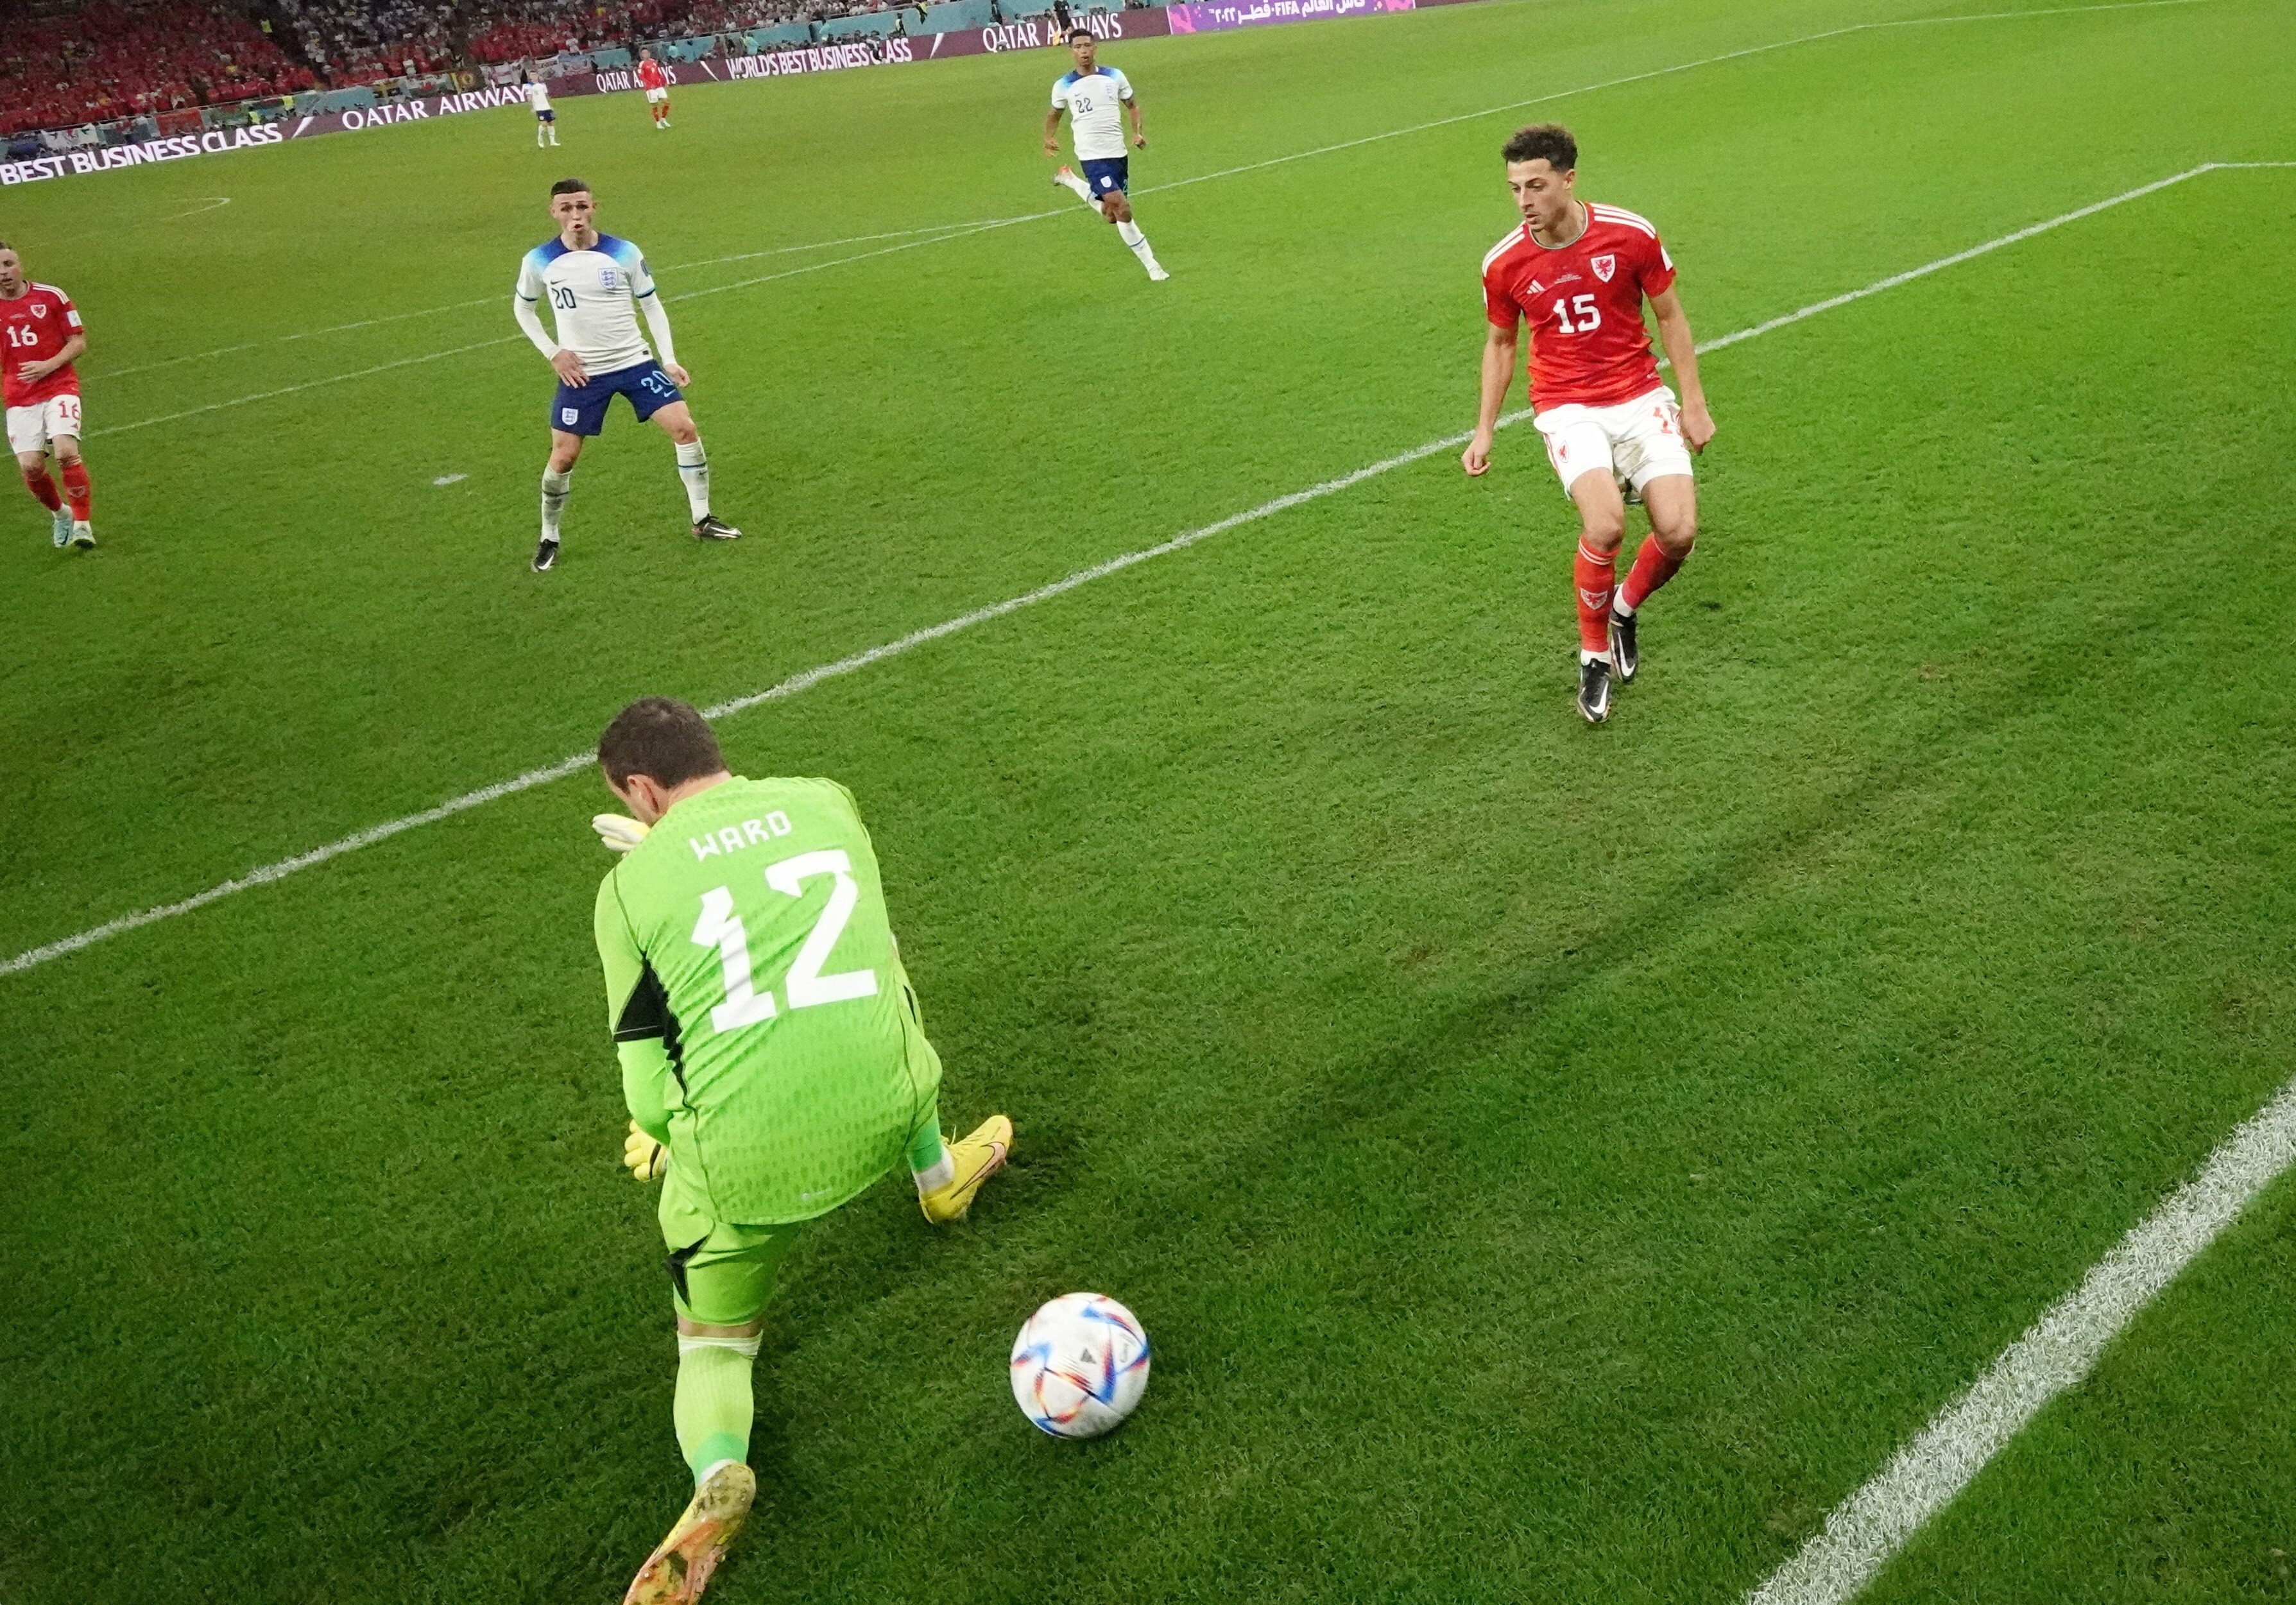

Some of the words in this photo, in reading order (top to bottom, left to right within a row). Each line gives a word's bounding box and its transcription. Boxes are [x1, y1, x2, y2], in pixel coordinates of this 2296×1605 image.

[1274, 1, 1300, 16] FIFA
[982, 22, 1040, 53] QATAR
[725, 53, 780, 80] WORLD'S
[776, 49, 807, 74] BEST
[807, 42, 870, 72] BUSINESS
[596, 71, 631, 94] QATAR
[342, 100, 429, 130] QATAR
[440, 82, 527, 116] AIRWAY
[1075, 98, 1093, 113] 22
[0, 155, 65, 185] BEST
[69, 135, 201, 174] BUSINESS
[201, 122, 282, 153] CLASS
[551, 287, 576, 309] 20
[1553, 293, 1601, 334] 15
[6, 324, 39, 347] 16
[641, 370, 674, 394] 20
[58, 400, 80, 420] 16
[689, 810, 792, 862] WARD
[690, 849, 878, 1033] 12
